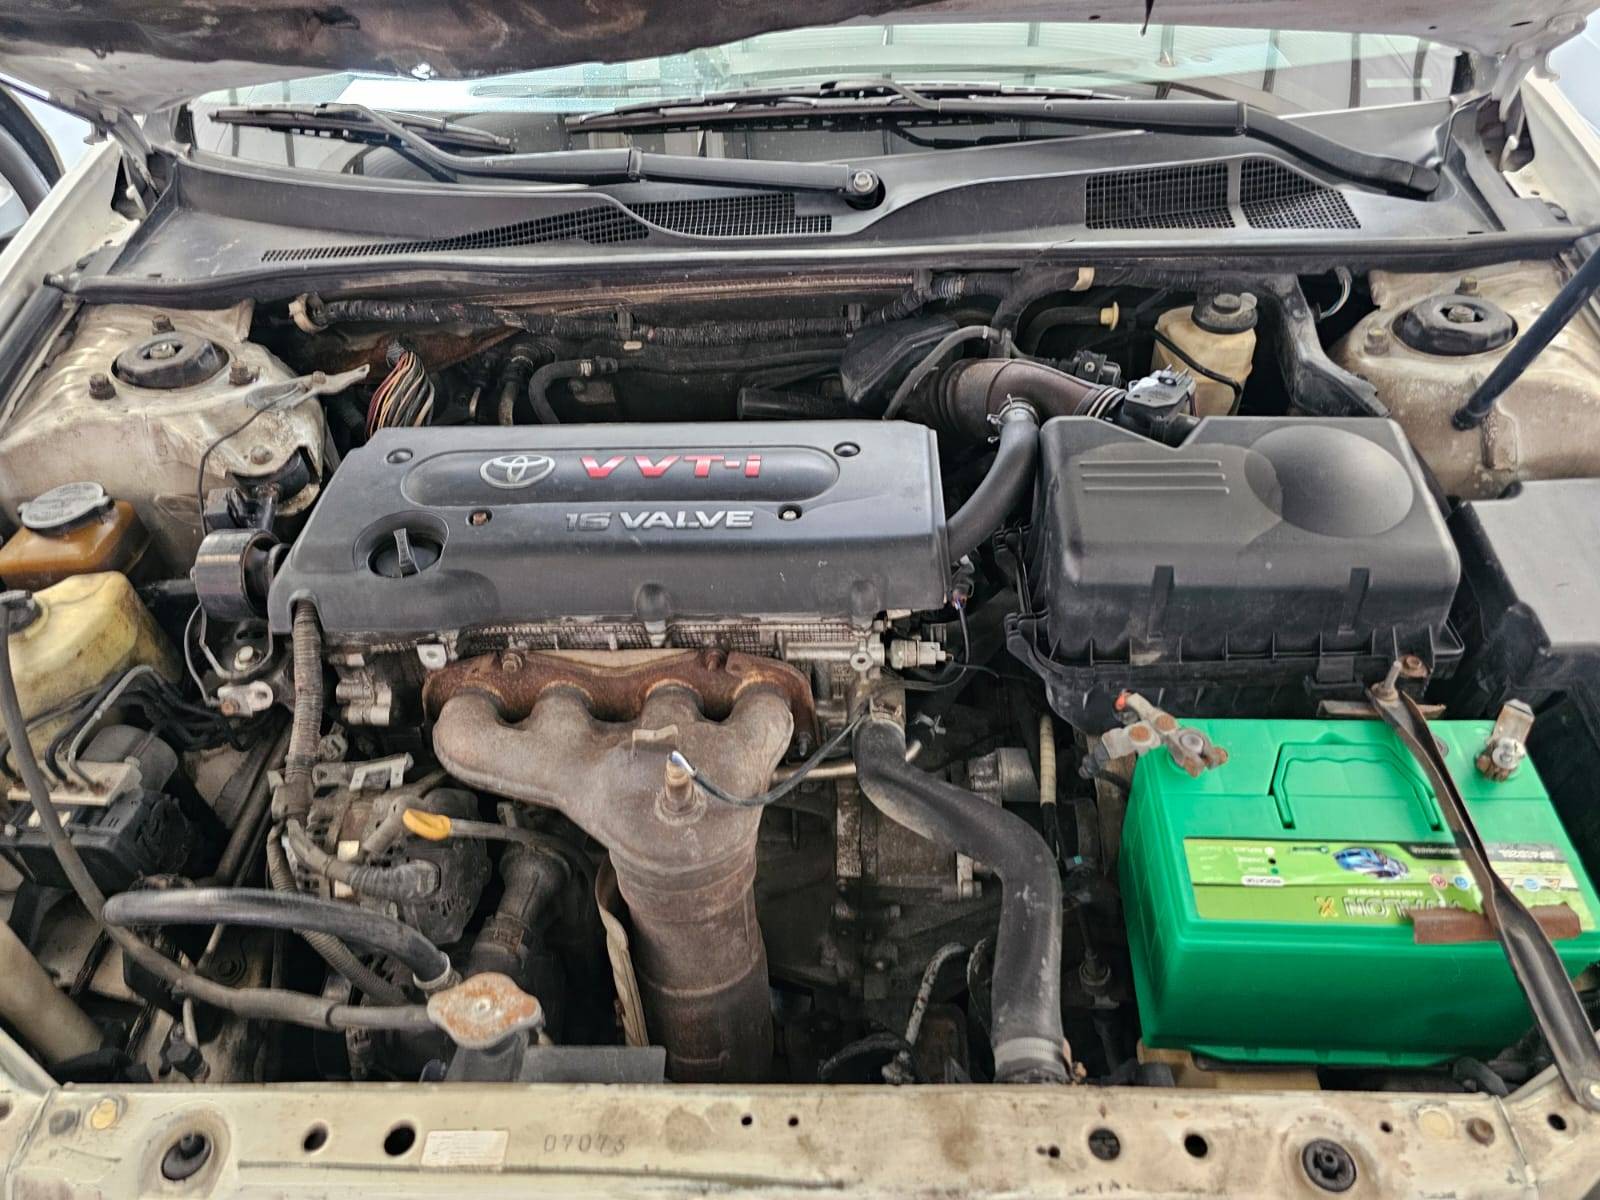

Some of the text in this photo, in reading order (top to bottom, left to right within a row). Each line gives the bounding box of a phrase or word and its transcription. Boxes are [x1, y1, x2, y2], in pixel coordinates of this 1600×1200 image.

[580, 455, 762, 478] VVT-i
[566, 510, 755, 531] 16 VALVE
[1314, 895, 1338, 919] X
